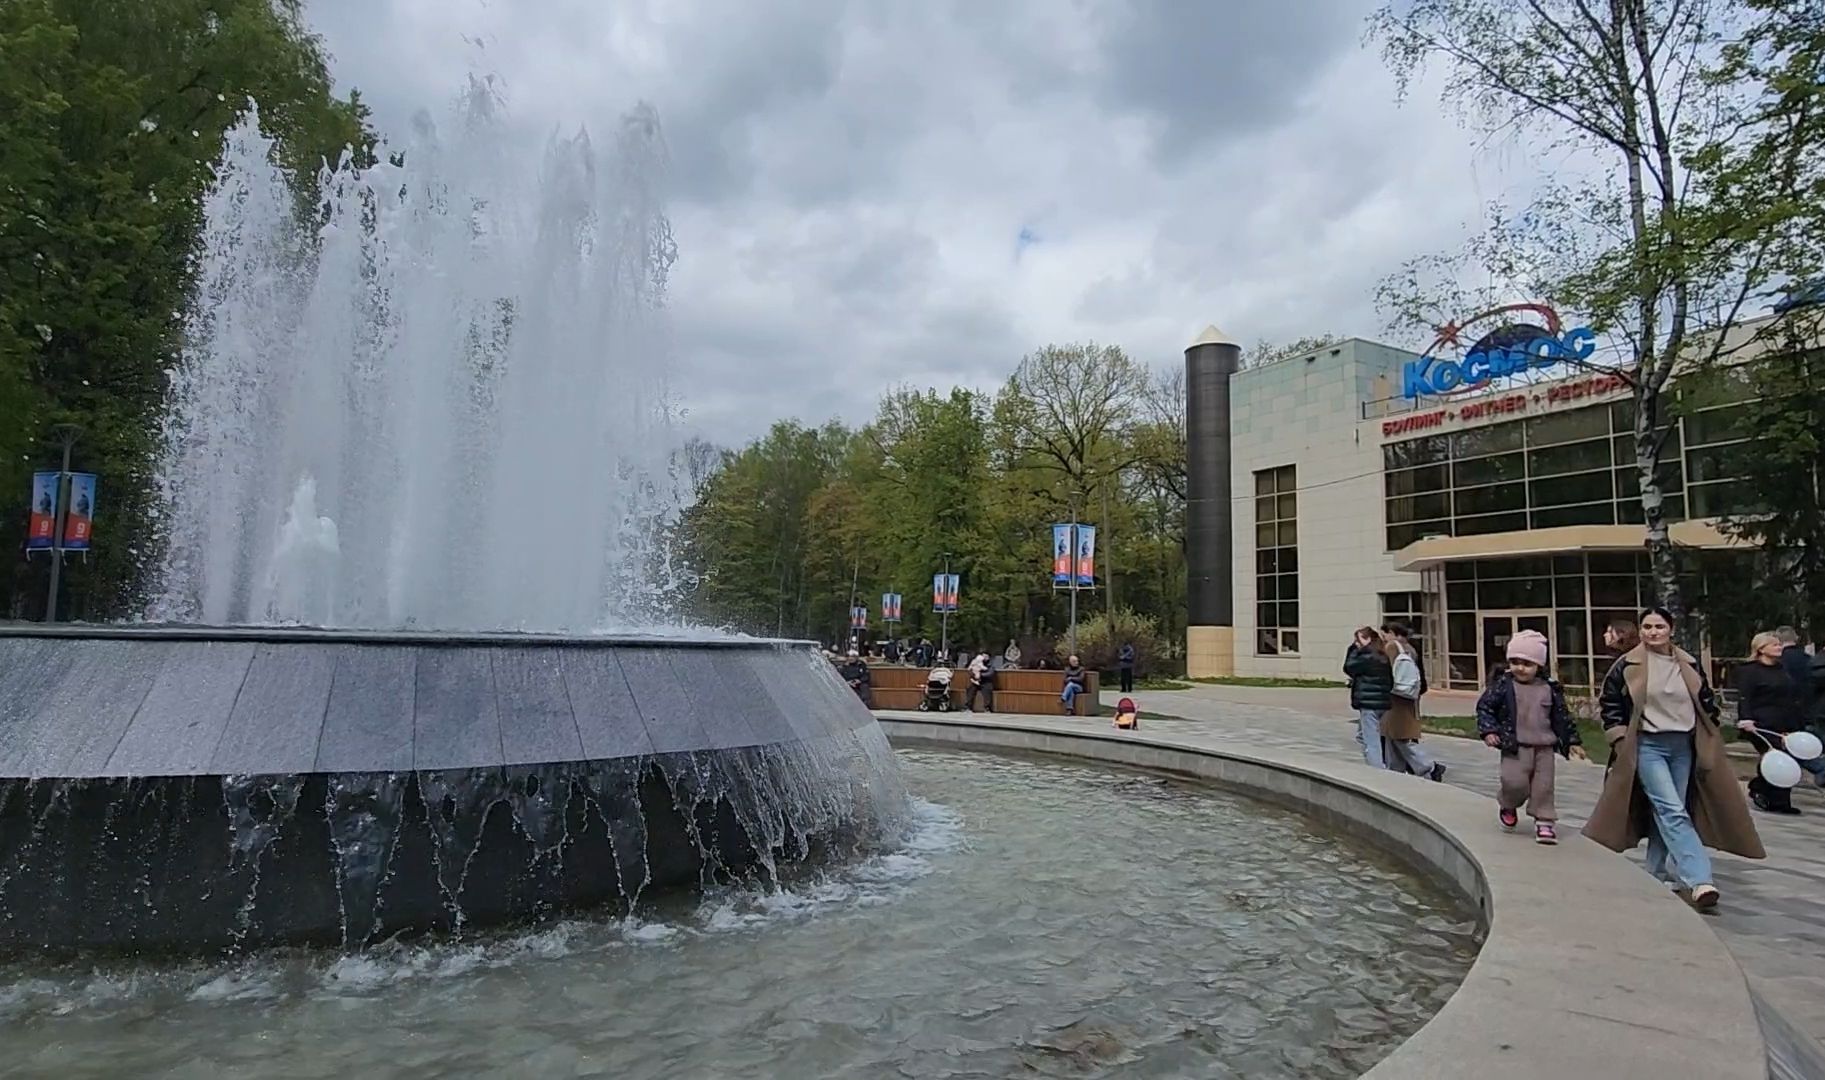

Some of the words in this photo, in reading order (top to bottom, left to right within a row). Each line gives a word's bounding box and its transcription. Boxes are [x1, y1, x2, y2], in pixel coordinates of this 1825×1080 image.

[1404, 328, 1596, 399] КОСМОС
[1382, 411, 1445, 437] БОУЛИНГ
[1460, 394, 1525, 420] ФИТНЕС
[78, 523, 85, 533] 9
